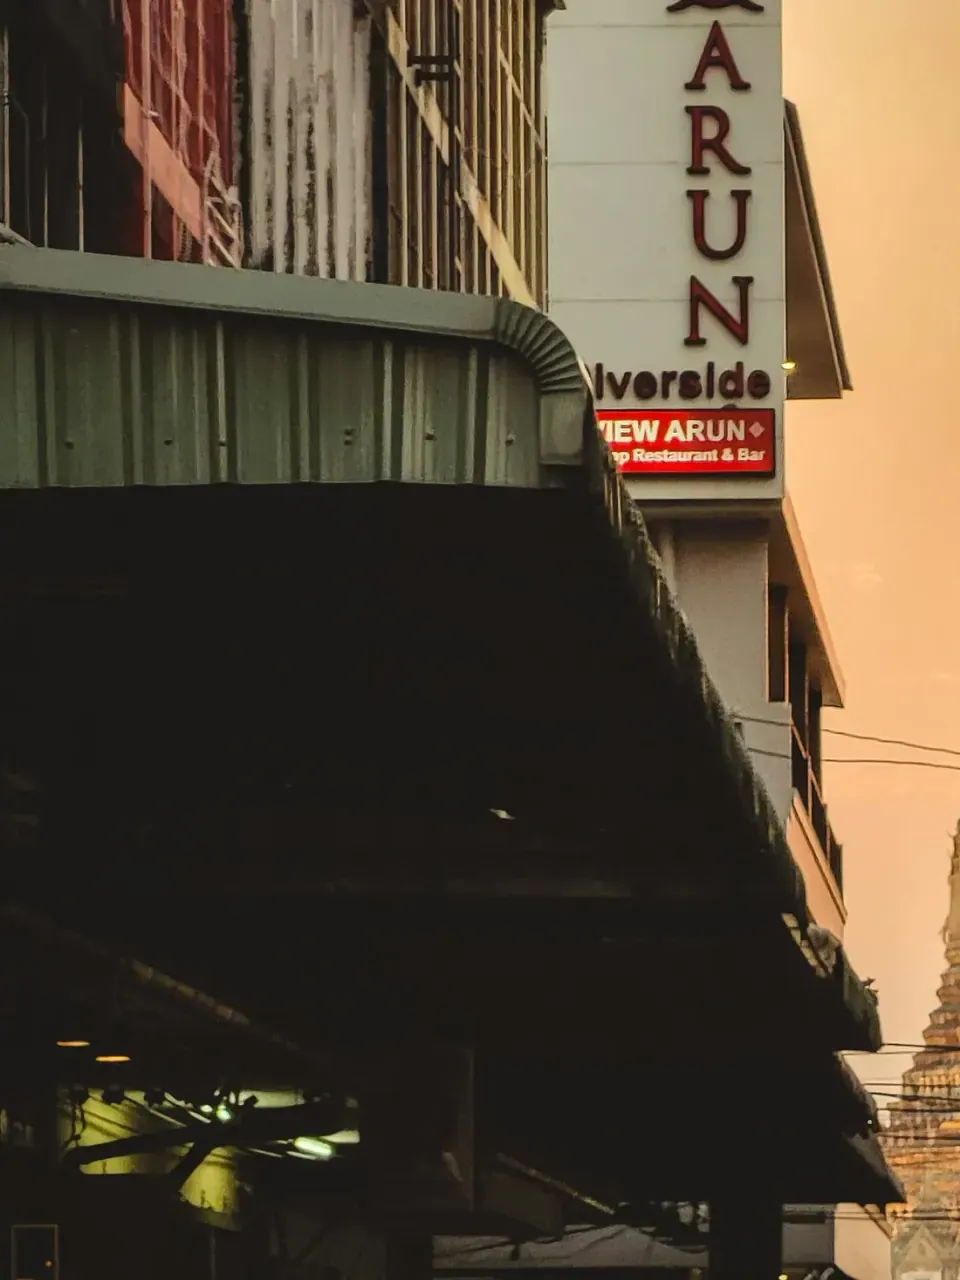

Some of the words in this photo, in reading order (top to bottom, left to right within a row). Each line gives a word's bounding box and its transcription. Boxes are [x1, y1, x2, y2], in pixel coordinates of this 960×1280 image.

[684, 19, 754, 347] ARUN
[663, 418, 745, 443] ARUN
[632, 447, 718, 463] Restaurant
[721, 448, 734, 461] &
[737, 447, 766, 461] Bar
